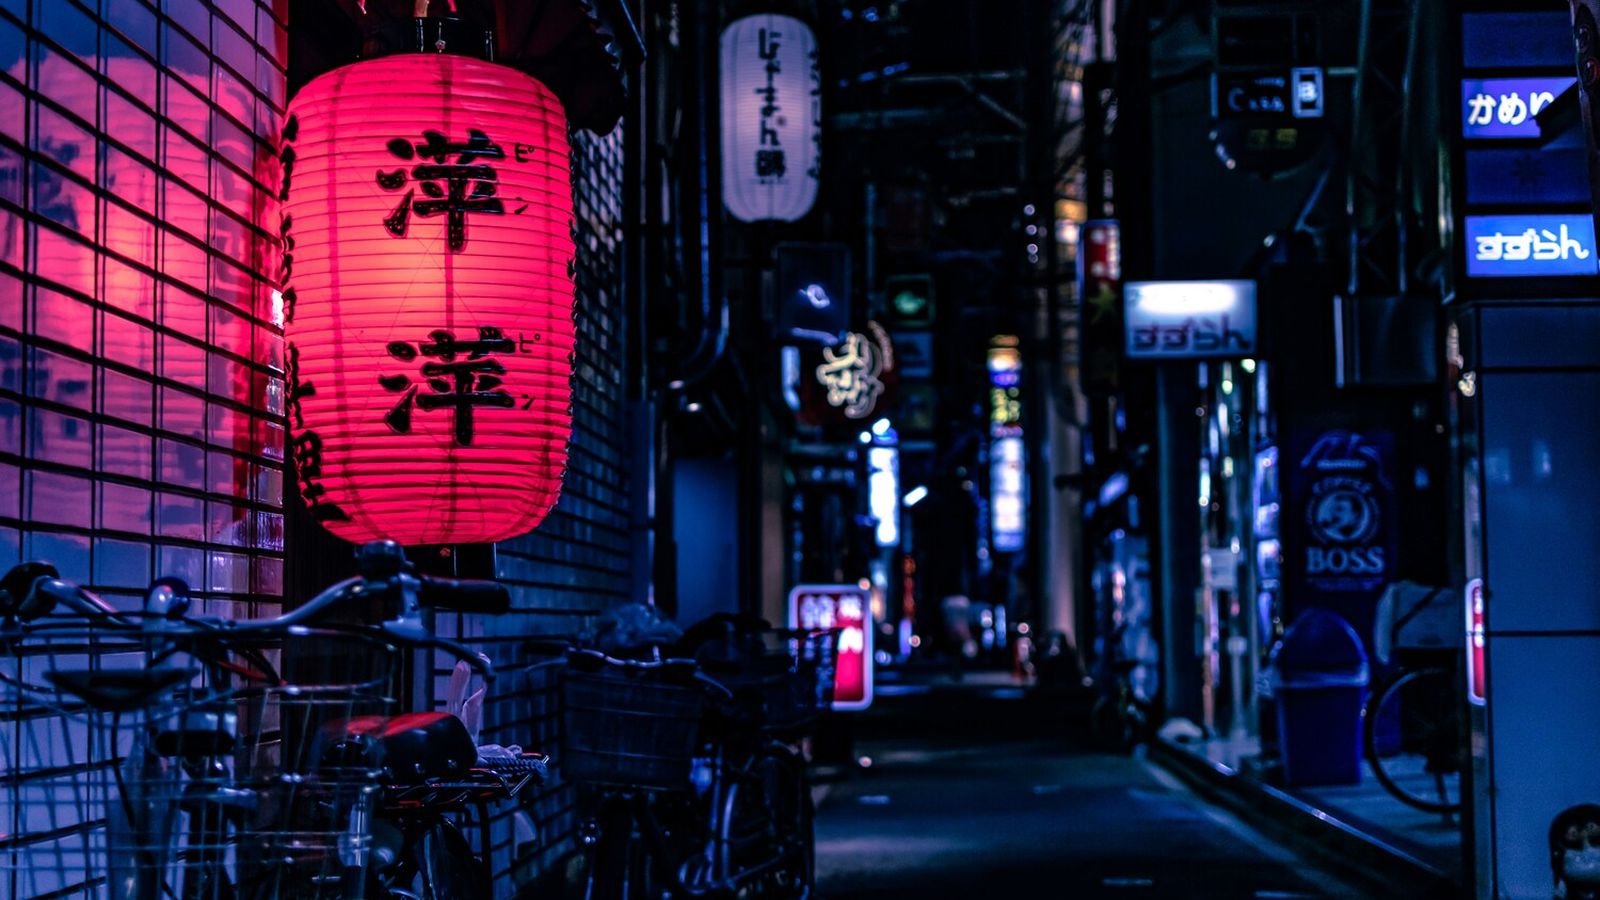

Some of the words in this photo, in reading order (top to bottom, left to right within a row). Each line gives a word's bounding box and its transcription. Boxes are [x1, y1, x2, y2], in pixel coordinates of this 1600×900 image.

[1475, 223, 1590, 261] すずらん
[1132, 312, 1250, 351] すずらん
[1306, 545, 1385, 574] BOSS
